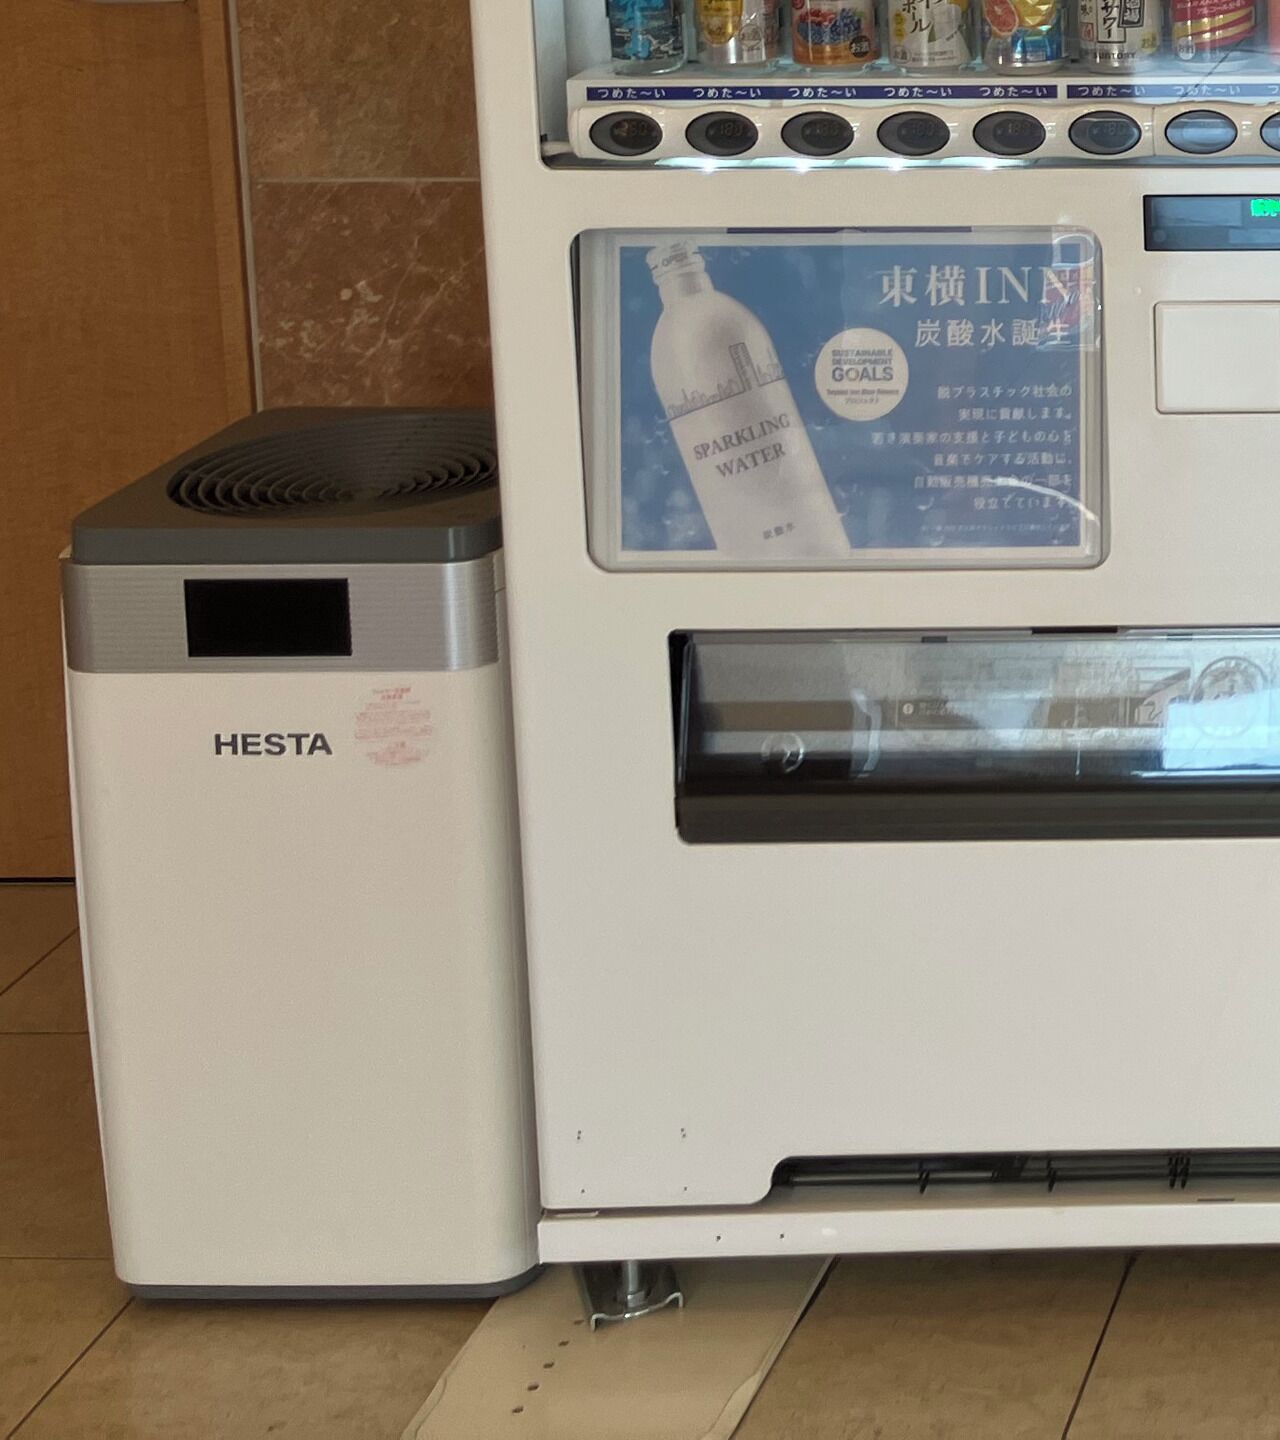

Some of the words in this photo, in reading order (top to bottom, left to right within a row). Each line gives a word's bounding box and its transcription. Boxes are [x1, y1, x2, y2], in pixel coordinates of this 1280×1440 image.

[914, 319, 1074, 348] 炭酸水誕生
[831, 367, 894, 383] GOALS
[693, 412, 791, 461] SPARKLING
[715, 442, 788, 479] WATER
[213, 733, 333, 756] HESTA
